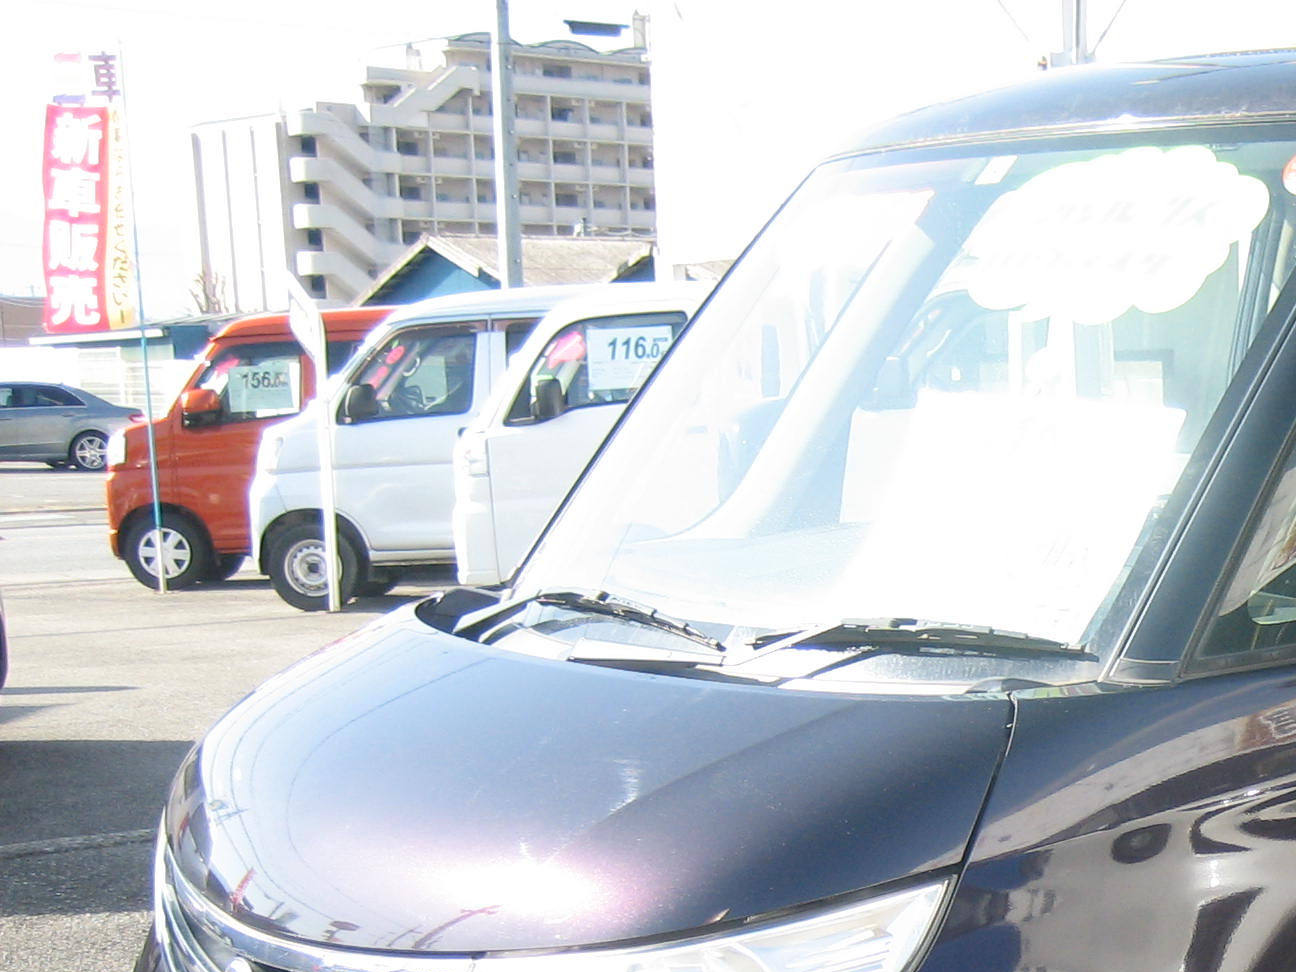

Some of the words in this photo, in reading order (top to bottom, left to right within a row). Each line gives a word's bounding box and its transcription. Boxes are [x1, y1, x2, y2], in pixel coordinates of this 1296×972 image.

[49, 112, 104, 325] 新車販売
[608, 335, 660, 360] 116.0
